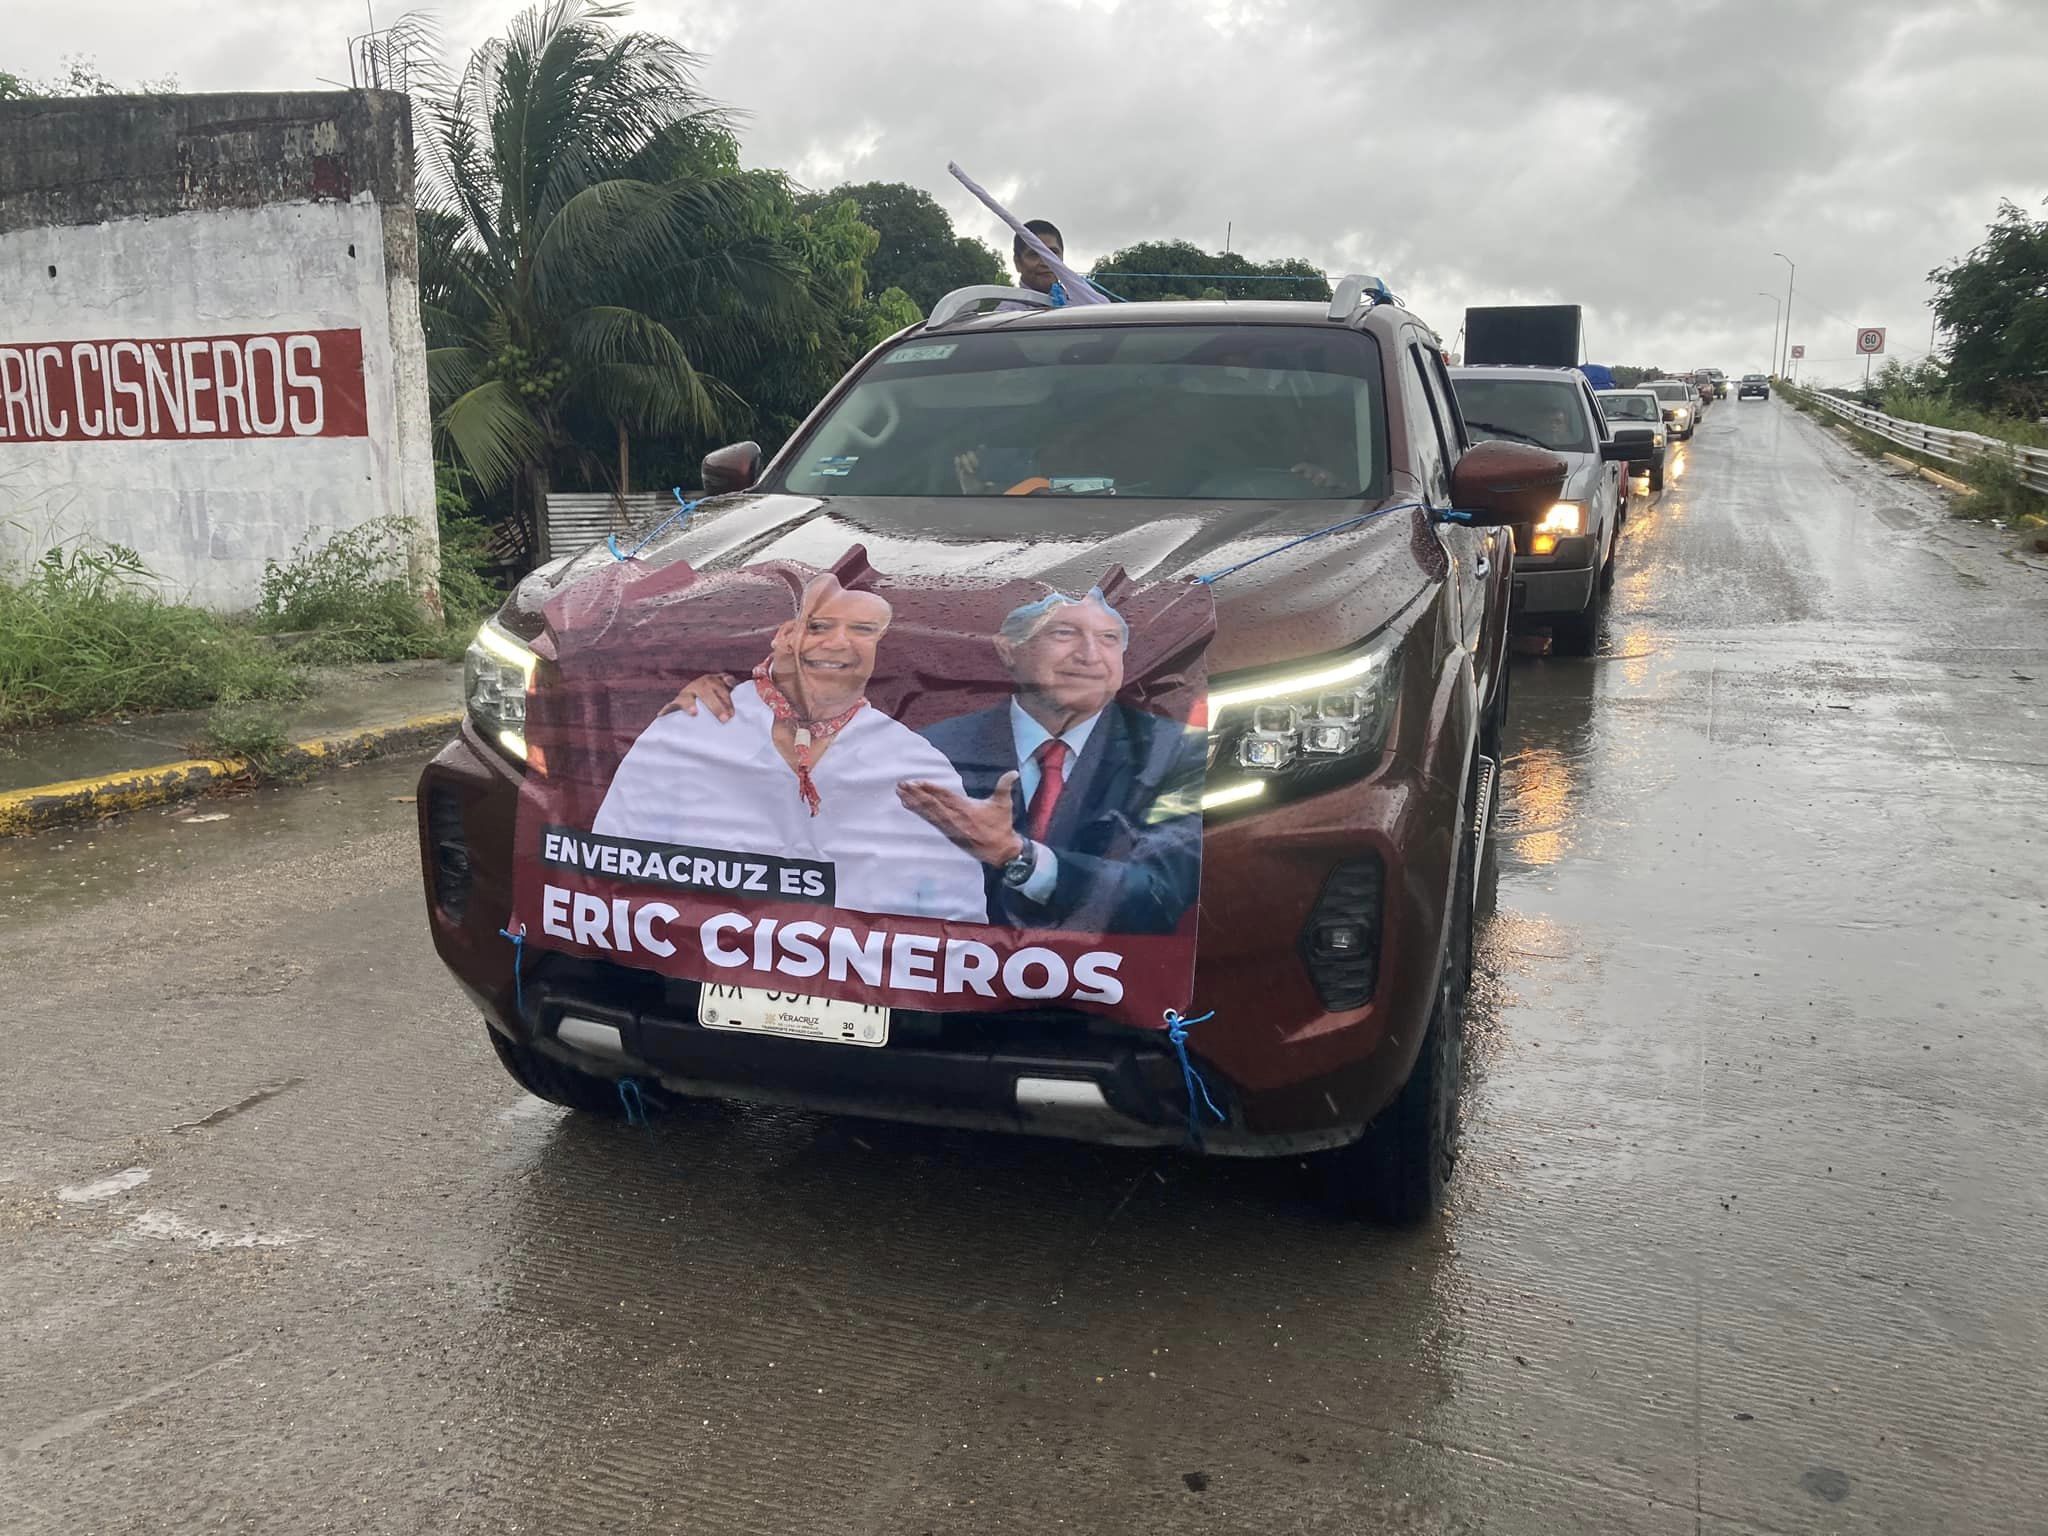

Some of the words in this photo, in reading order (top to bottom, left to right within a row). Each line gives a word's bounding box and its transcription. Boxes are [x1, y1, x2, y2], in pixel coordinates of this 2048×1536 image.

[1865, 334, 1876, 344] 60
[0, 347, 68, 437] RIC
[71, 335, 324, 436] CISNEROS
[544, 833, 577, 865] EN
[581, 842, 768, 891] VERACRUZ
[780, 867, 826, 897] ES
[543, 884, 680, 957] ERIC
[701, 912, 1124, 1005] CISNEROS
[779, 1013, 819, 1025] VERACRUZ
[842, 1022, 854, 1030] 30
